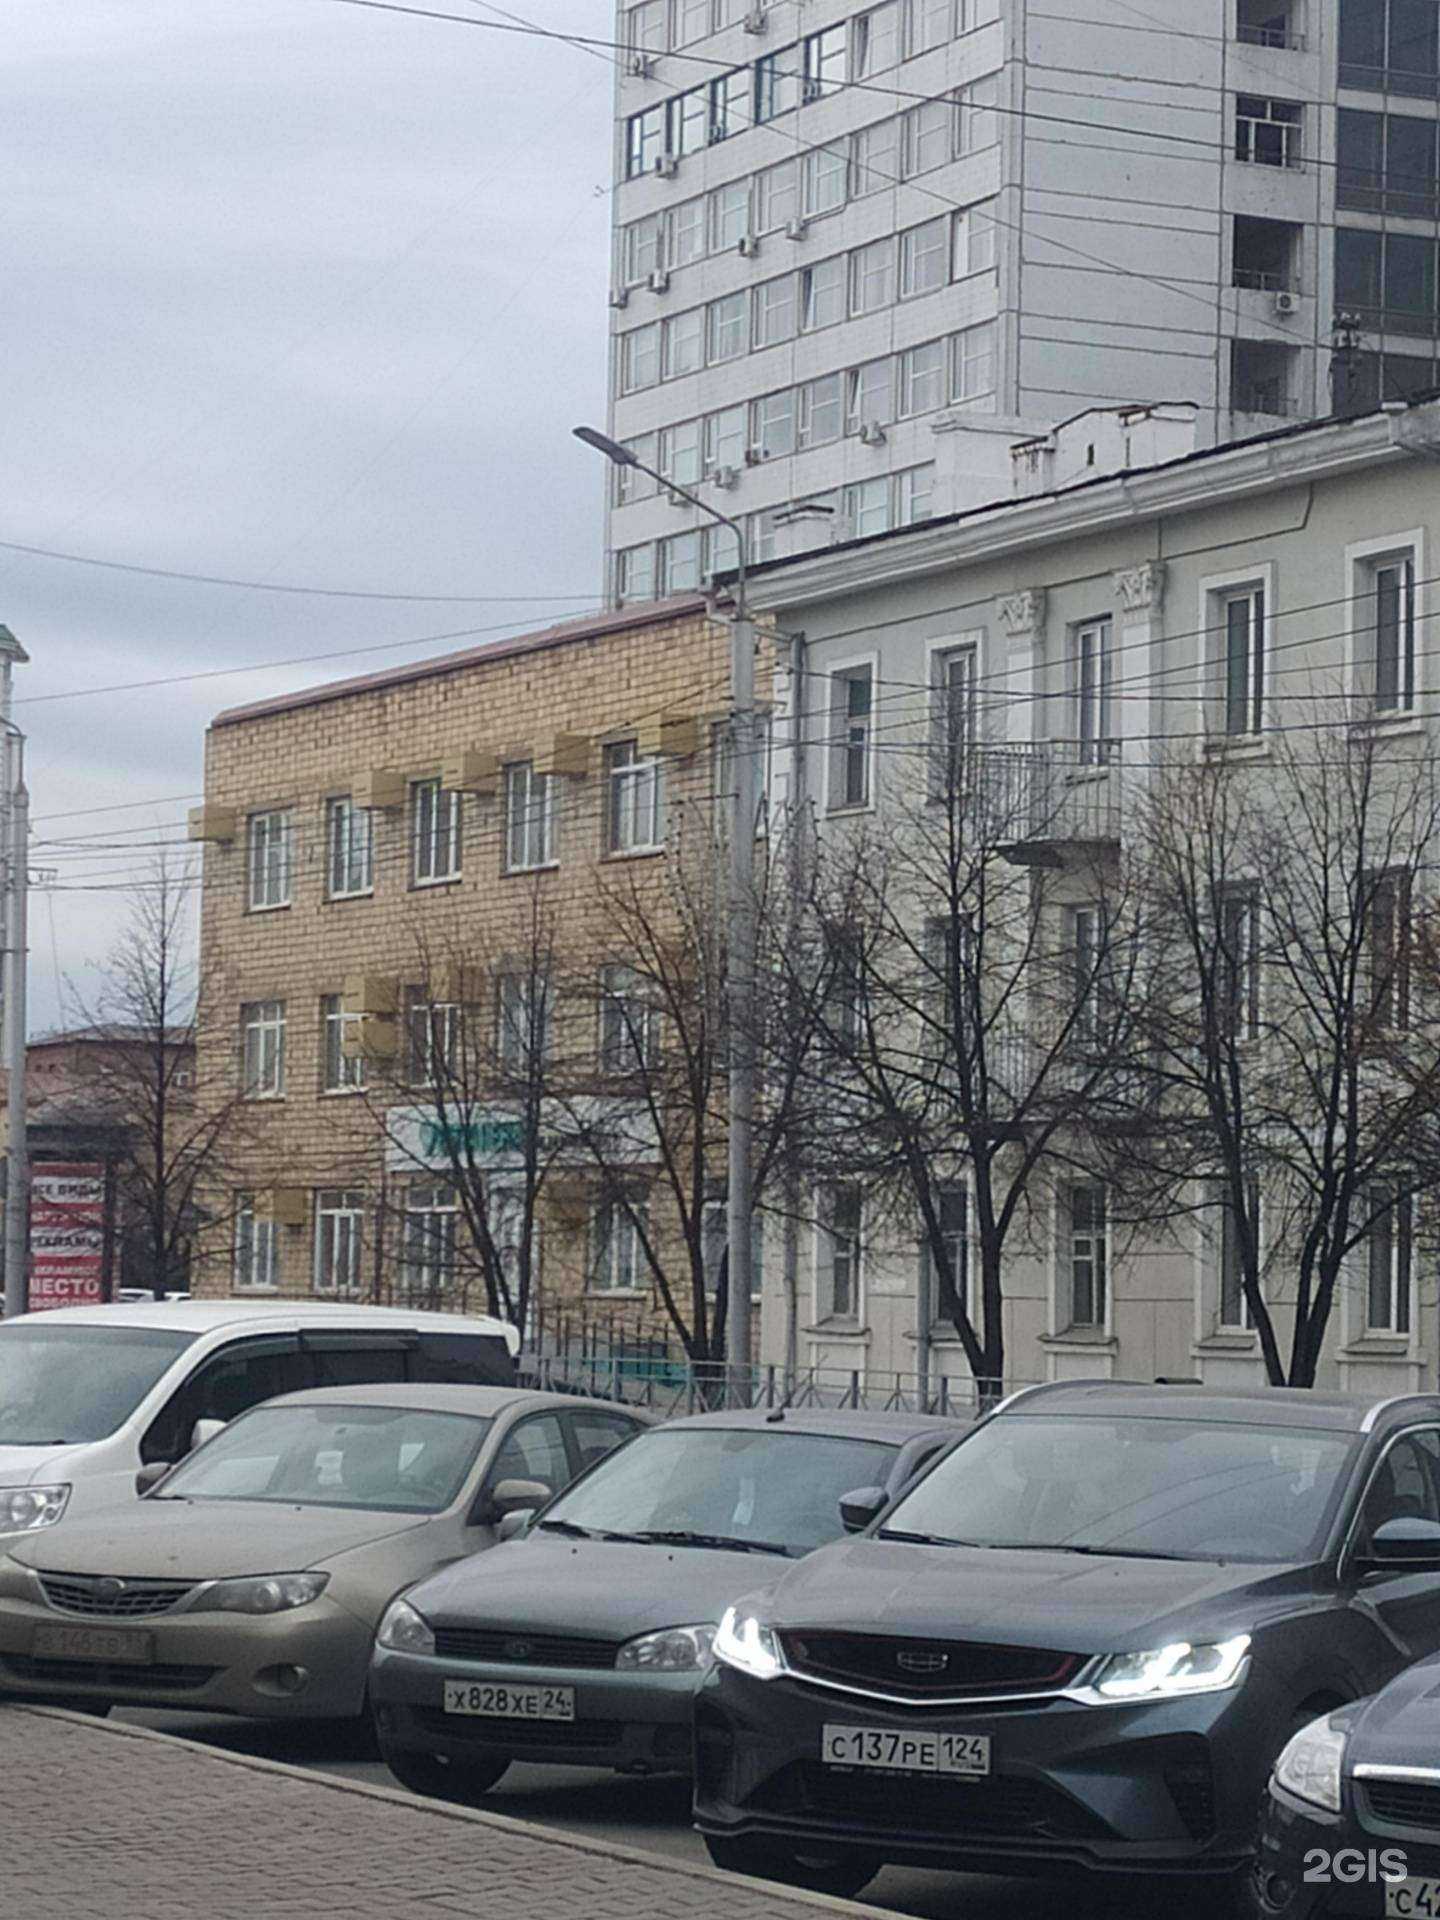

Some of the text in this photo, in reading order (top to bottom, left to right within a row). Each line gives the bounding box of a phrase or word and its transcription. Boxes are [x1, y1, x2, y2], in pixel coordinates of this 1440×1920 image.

[453, 1686, 538, 1714] Х828ХЕ
[831, 1731, 985, 1766] С137РЕ 124
